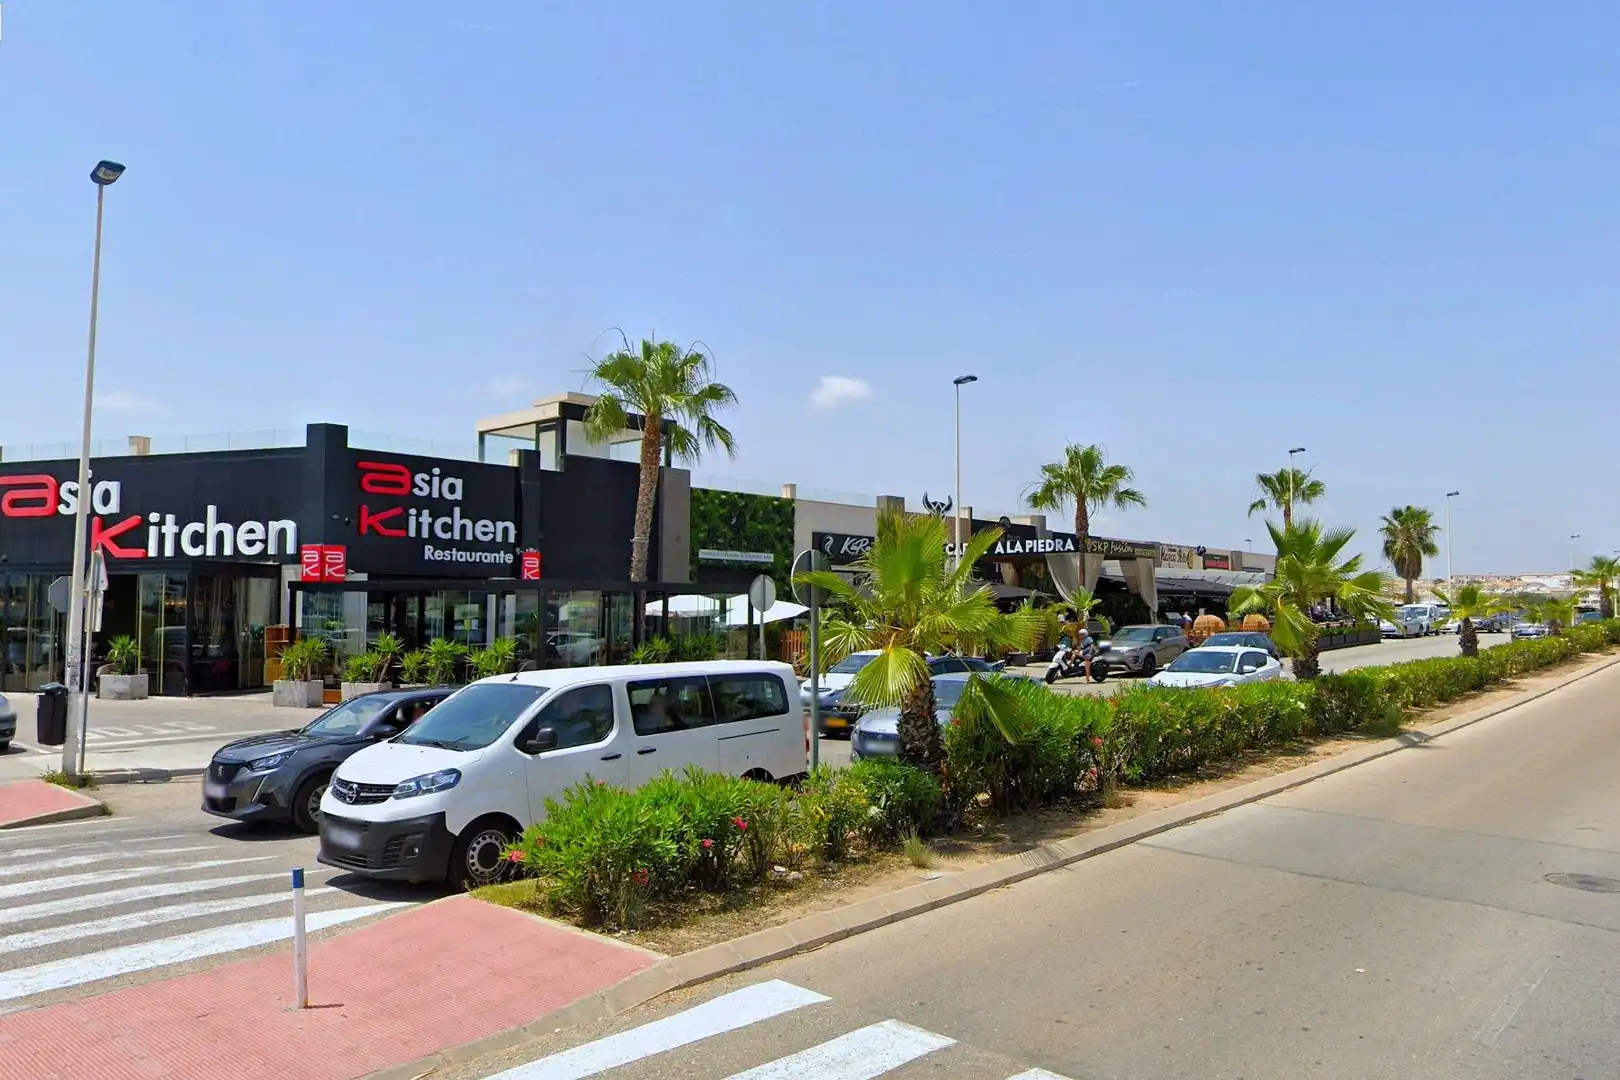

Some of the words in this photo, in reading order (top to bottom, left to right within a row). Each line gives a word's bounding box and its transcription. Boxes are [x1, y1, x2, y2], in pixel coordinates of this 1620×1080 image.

[91, 505, 298, 559] Kitchen
[358, 504, 516, 544] Kitchen
[424, 545, 514, 564] Restaurante
[995, 541, 1005, 555] A
[1006, 540, 1024, 554] LA
[1025, 538, 1075, 553] PIEDRA
[1092, 540, 1109, 554] SKP
